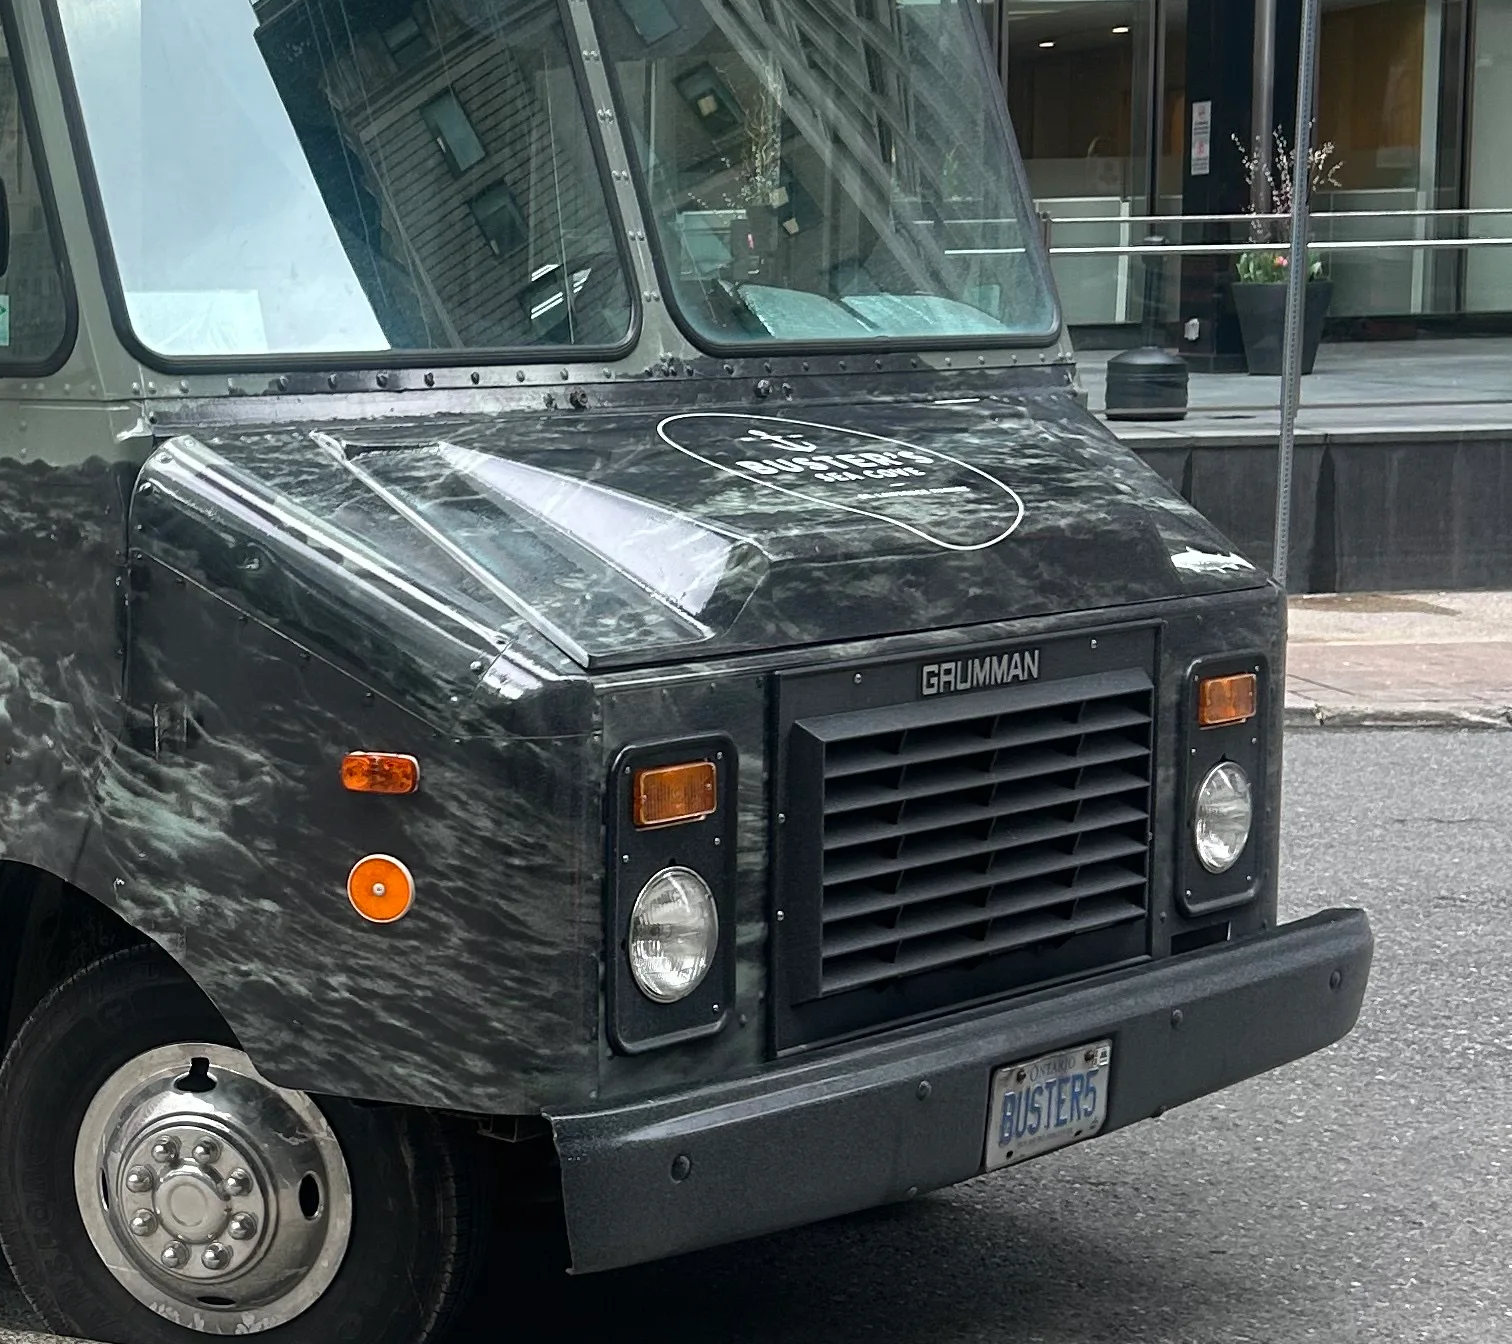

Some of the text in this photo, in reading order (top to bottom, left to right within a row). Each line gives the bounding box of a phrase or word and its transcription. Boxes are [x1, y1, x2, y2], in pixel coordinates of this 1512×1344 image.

[735, 450, 935, 475] BUSTER'S
[814, 466, 927, 483] SEA COVE
[921, 649, 1040, 696] GRUMMAN
